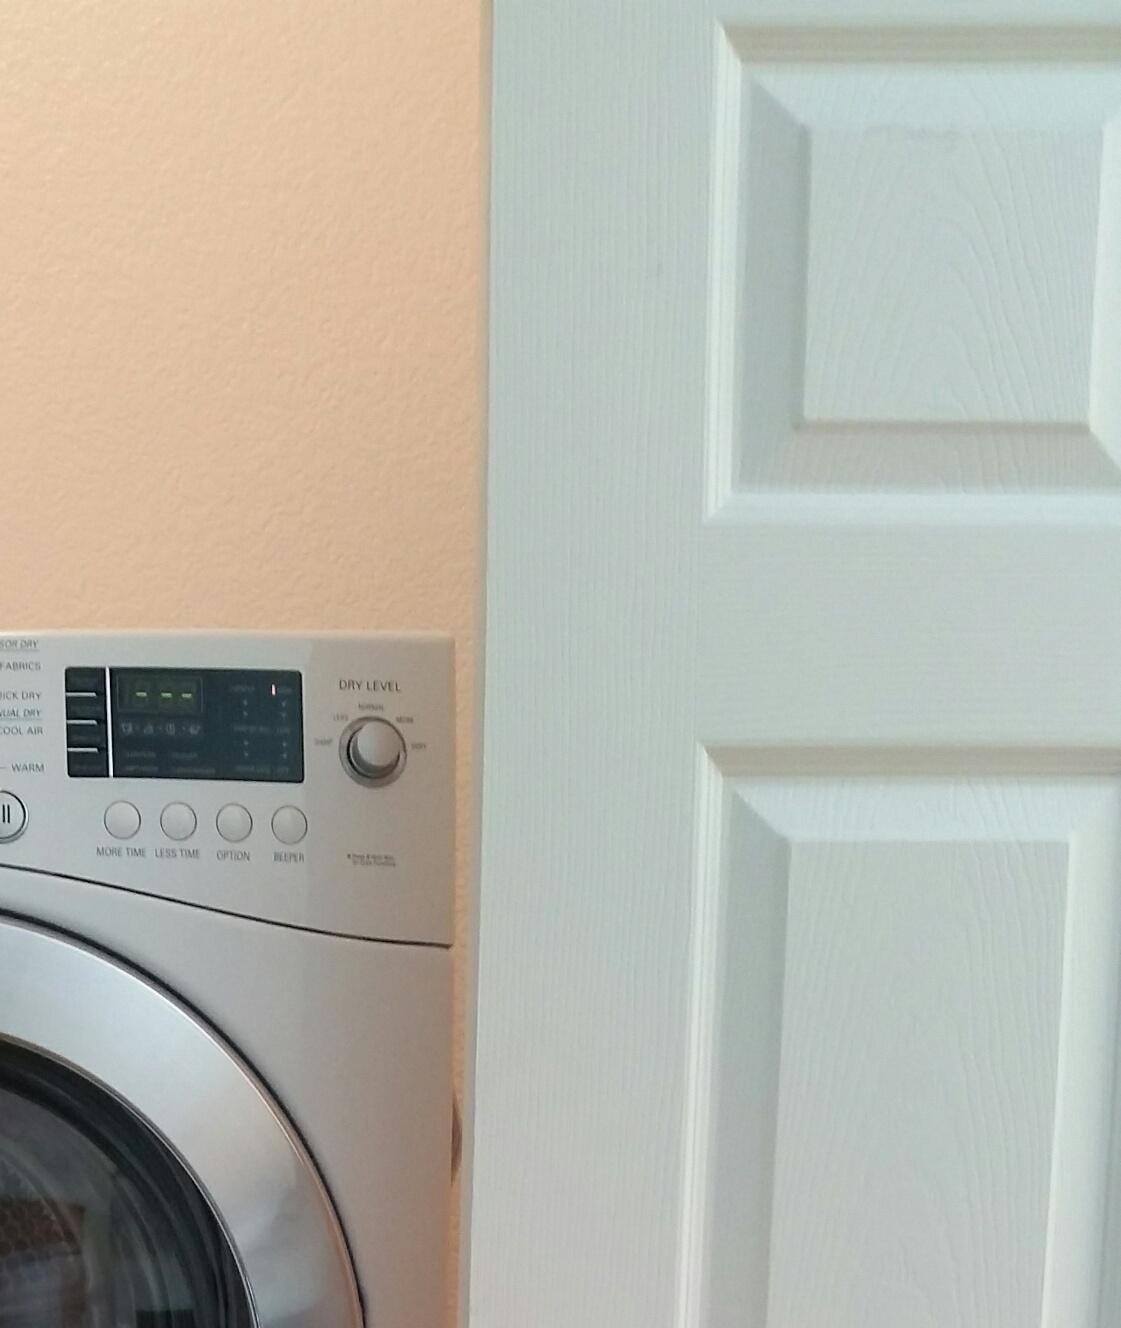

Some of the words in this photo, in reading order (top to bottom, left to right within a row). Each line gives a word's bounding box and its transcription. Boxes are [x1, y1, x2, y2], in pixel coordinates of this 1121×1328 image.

[21, 640, 38, 648] DRY
[0, 662, 41, 670] FABRICS
[339, 680, 361, 690] DRY
[367, 680, 401, 691] LEVEL
[22, 691, 41, 699] DRY
[23, 709, 41, 717] DRY
[27, 727, 43, 735] AIR
[11, 763, 45, 772] WARM
[96, 847, 122, 857] MORE
[127, 847, 146, 857] TIME
[155, 848, 177, 858] LESS
[181, 849, 200, 859] TIME
[217, 850, 250, 861] OPTION
[273, 852, 305, 863] BEEPER
